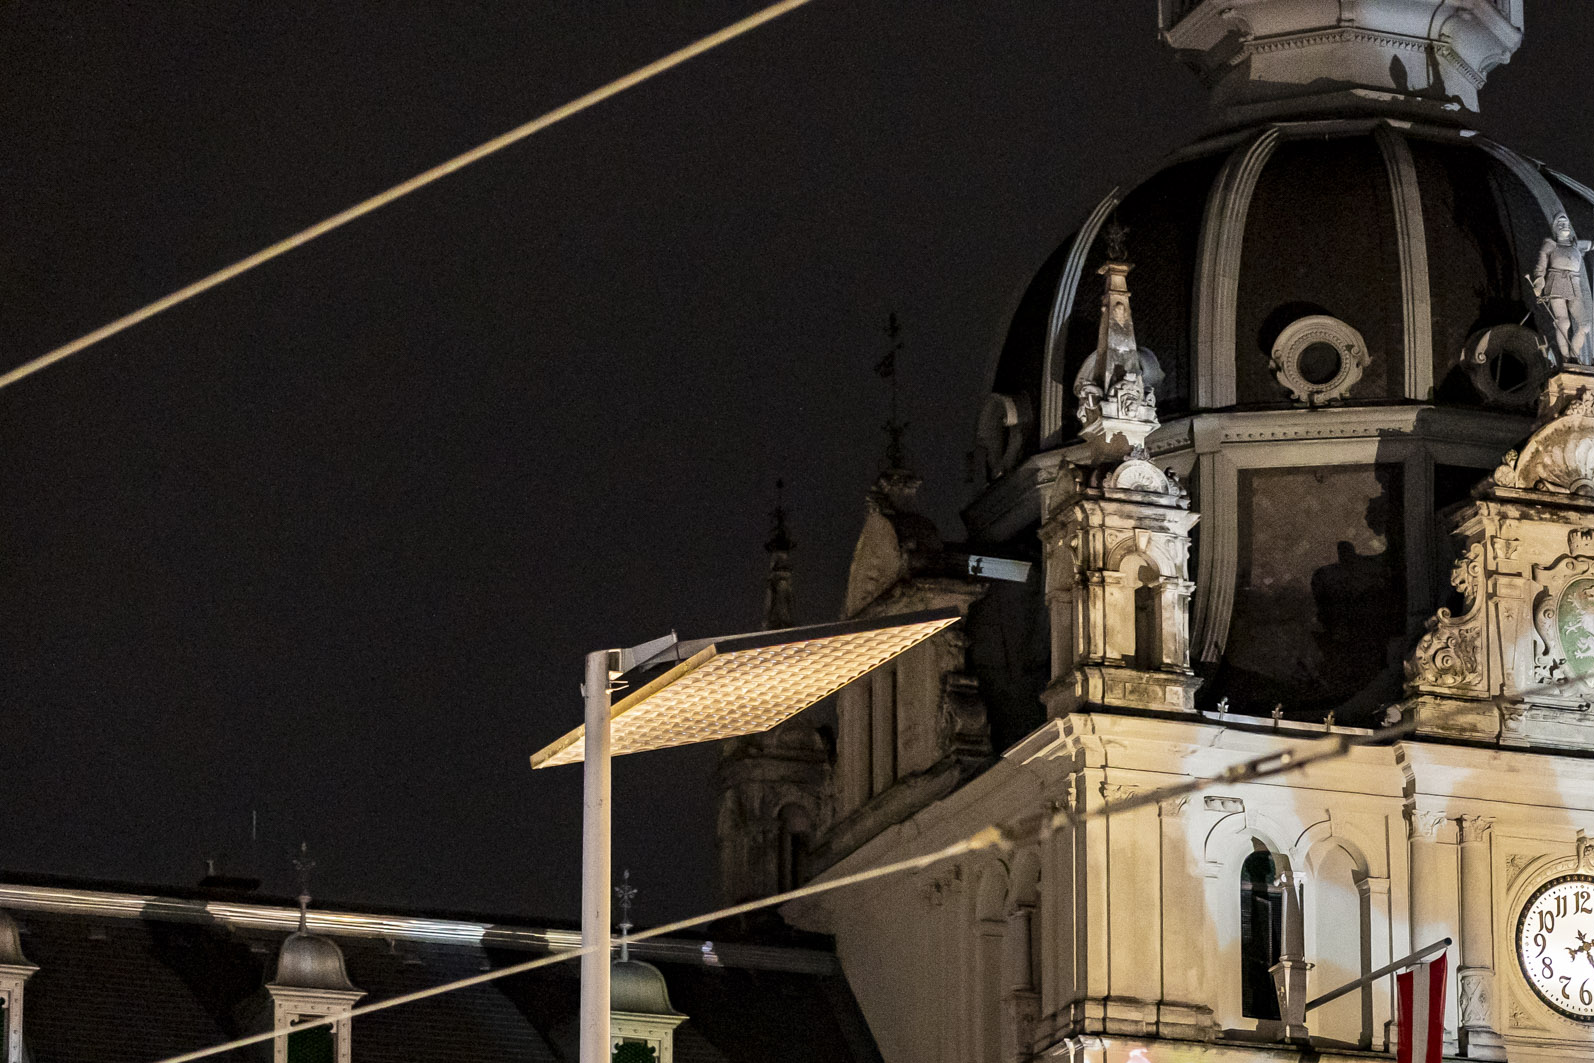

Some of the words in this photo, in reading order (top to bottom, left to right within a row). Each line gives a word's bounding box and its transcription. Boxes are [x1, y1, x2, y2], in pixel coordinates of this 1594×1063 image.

[1554, 895, 1567, 918] 11
[1573, 891, 1593, 915] 12
[1538, 910, 1554, 933] 10
[1534, 933, 1546, 958] 9
[1542, 957, 1553, 979] 8
[1559, 976, 1571, 1000] 7
[1579, 978, 1593, 1005] 6
